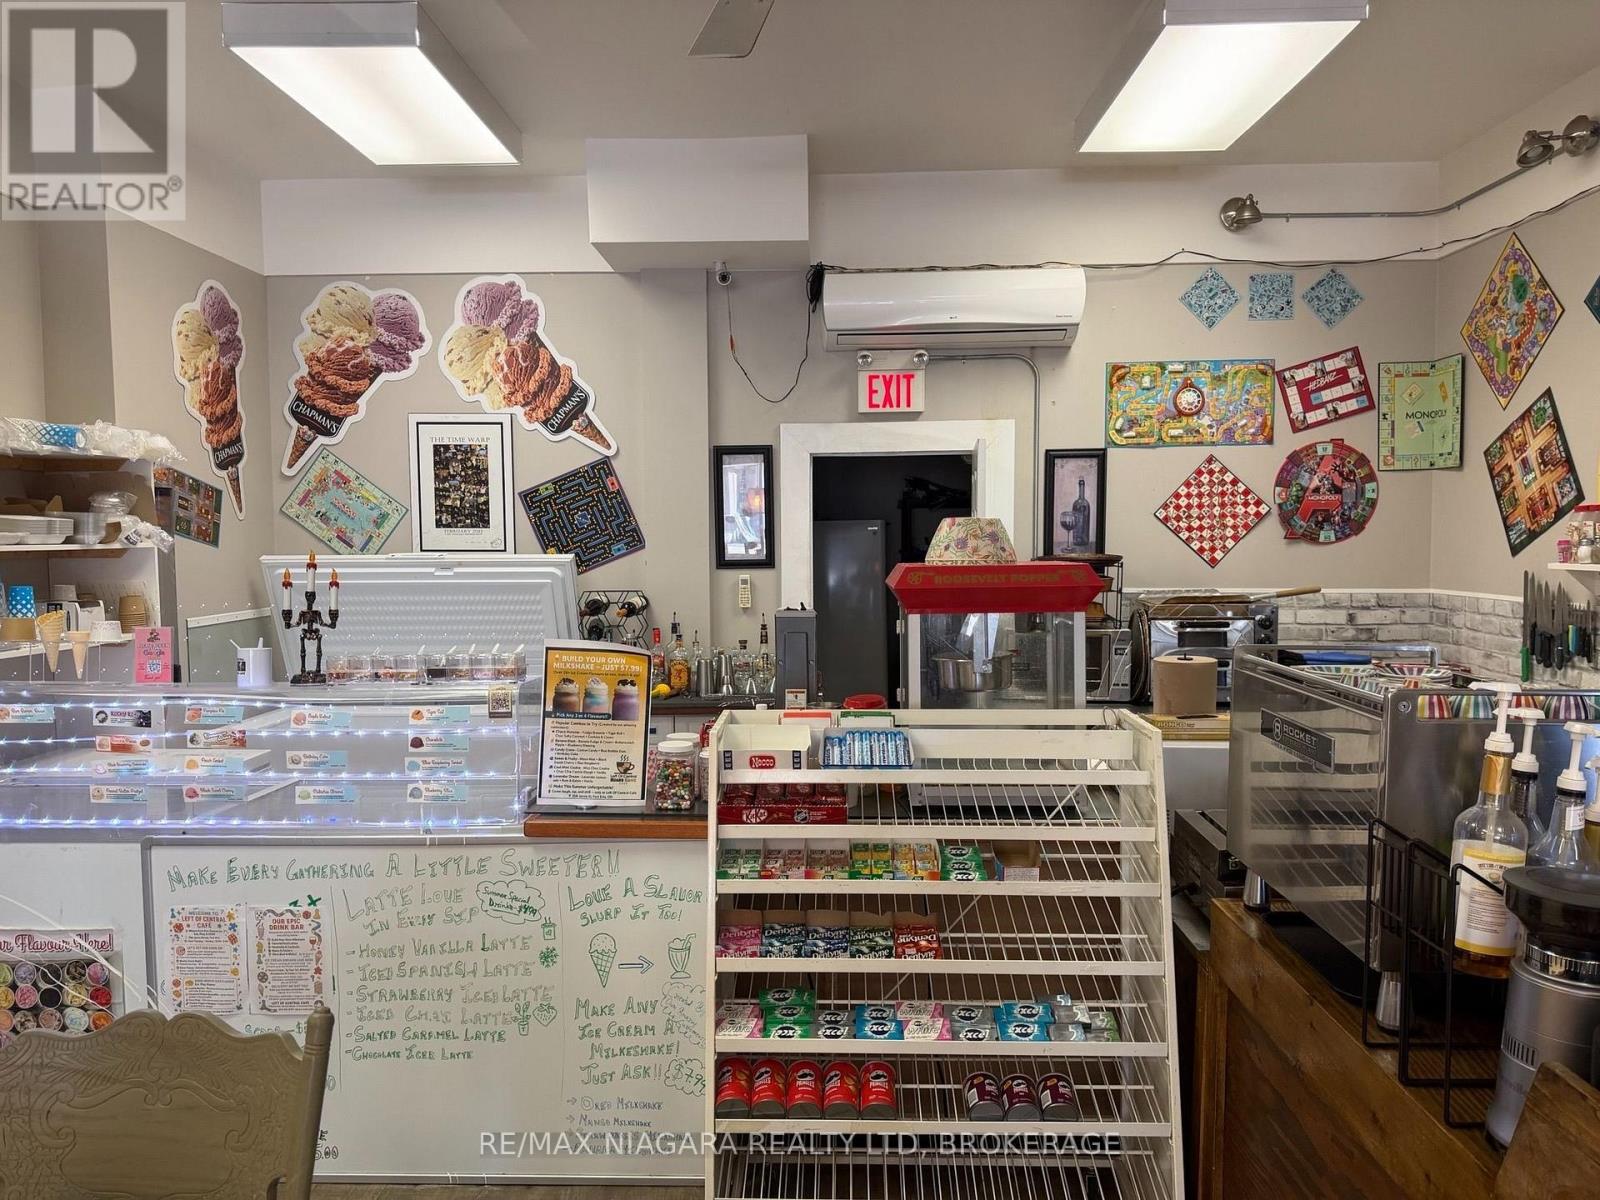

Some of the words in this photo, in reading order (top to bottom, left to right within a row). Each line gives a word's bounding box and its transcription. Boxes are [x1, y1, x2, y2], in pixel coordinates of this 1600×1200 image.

[867, 374, 915, 409] EXIT
[292, 400, 340, 434] CHAPMAN'S
[547, 388, 587, 432] CHAPMAN'S
[1406, 409, 1447, 419] MONOPOLY
[553, 662, 594, 671] MILKSHAKE
[562, 655, 584, 663] BUILD
[586, 656, 606, 664] YOUR
[607, 657, 626, 665] OWN
[1283, 724, 1317, 746] ROCKET
[166, 865, 218, 892] MAKE
[226, 857, 279, 884] EVERY
[285, 859, 374, 881] GATHERING
[385, 853, 402, 877] A
[414, 853, 492, 878] LITTLE
[623, 877, 638, 898] A
[342, 885, 413, 922] LATTE
[580, 907, 621, 927] SLURP
[721, 928, 759, 939] Dentyne
[764, 927, 802, 937] Dentyne
[809, 930, 847, 939] Dentyne
[15, 934, 71, 953] Flavour
[481, 933, 533, 952] LATTE
[480, 958, 535, 977] LATTE
[356, 985, 453, 1003] STRAWBERRY
[502, 984, 555, 1003] LATTE
[574, 997, 616, 1020] MAKE
[624, 996, 659, 1015] ANY
[952, 1008, 982, 1018] excel
[1014, 1005, 1043, 1015] excel
[607, 1020, 656, 1038] CREAM
[663, 1017, 676, 1036] A
[818, 1026, 849, 1037] excel
[865, 1023, 896, 1032] excel
[959, 1028, 990, 1040] excel
[1008, 1023, 1038, 1034] excel
